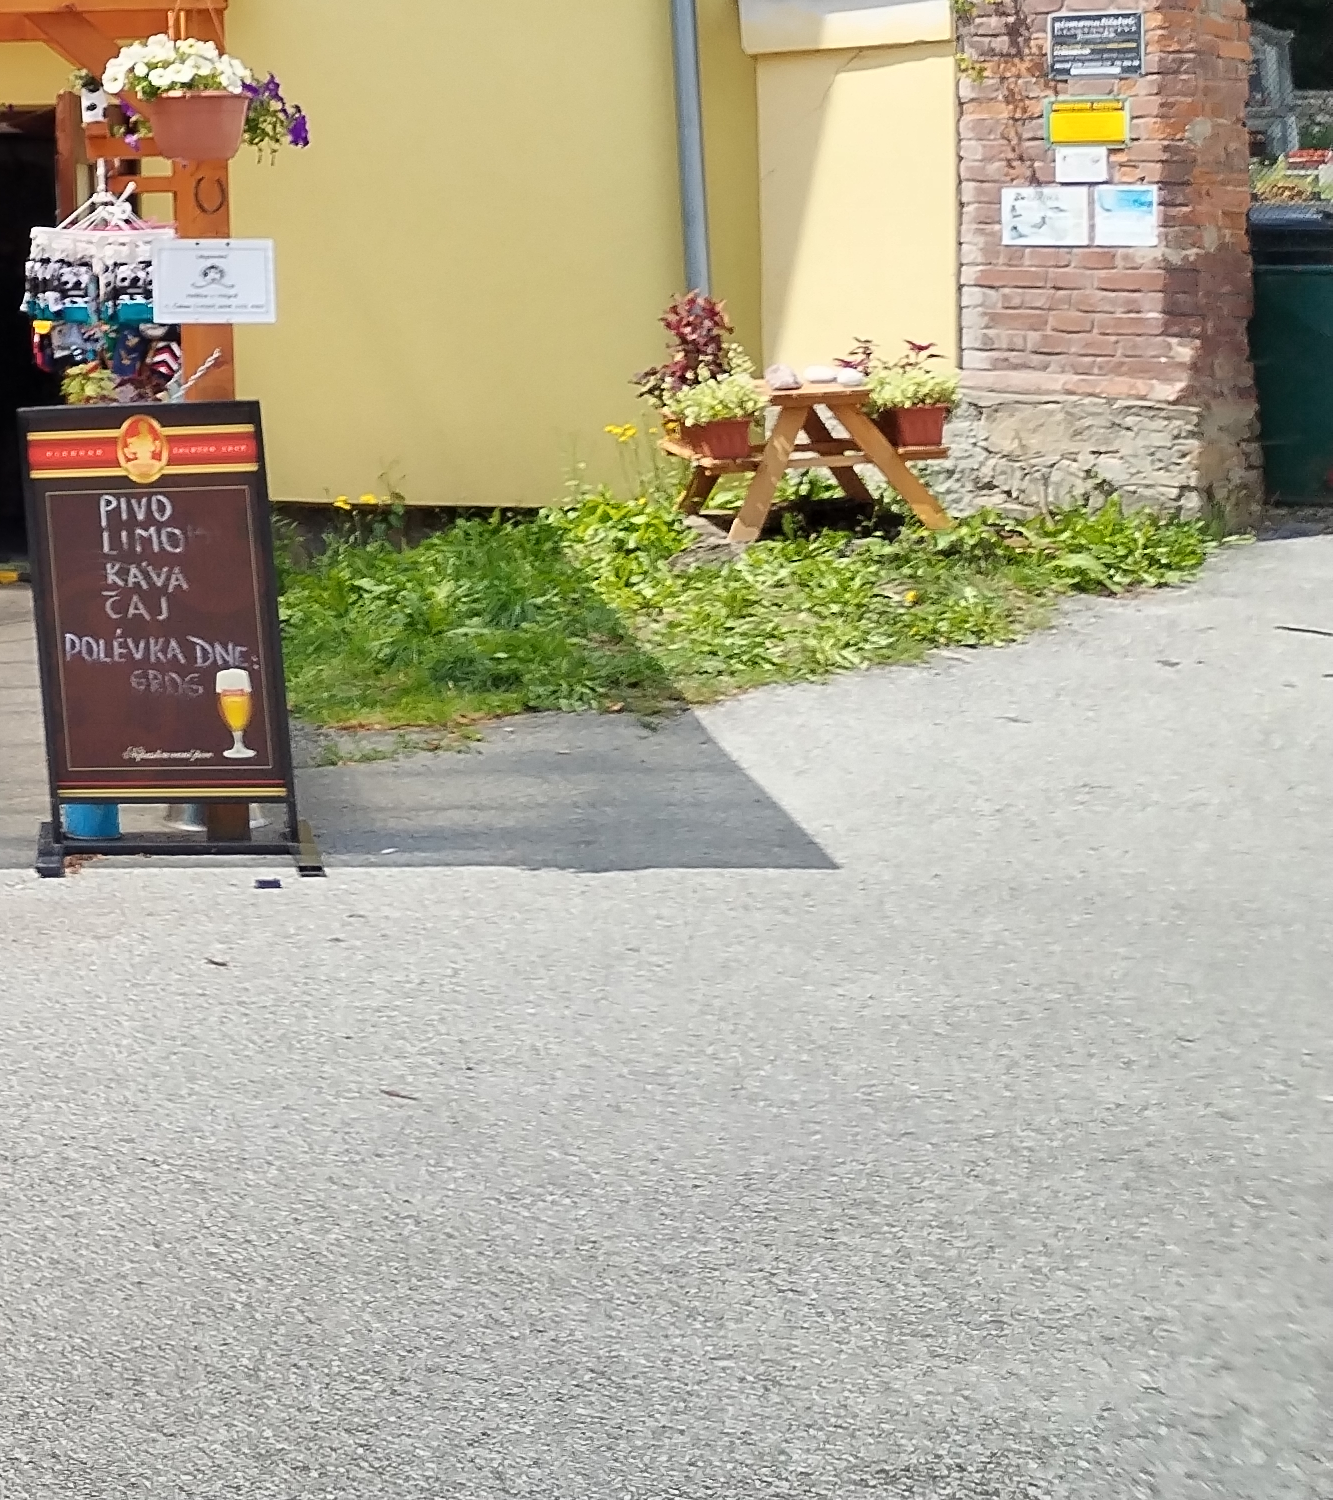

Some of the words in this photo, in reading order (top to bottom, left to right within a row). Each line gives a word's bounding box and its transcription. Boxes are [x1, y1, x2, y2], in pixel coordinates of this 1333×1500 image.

[99, 494, 173, 528] PIVO
[101, 526, 184, 555] LIMO
[105, 560, 190, 594] KÁVA
[101, 589, 170, 622] ČAJ
[64, 627, 186, 665] POLÉVKA
[186, 635, 260, 670] DNE:
